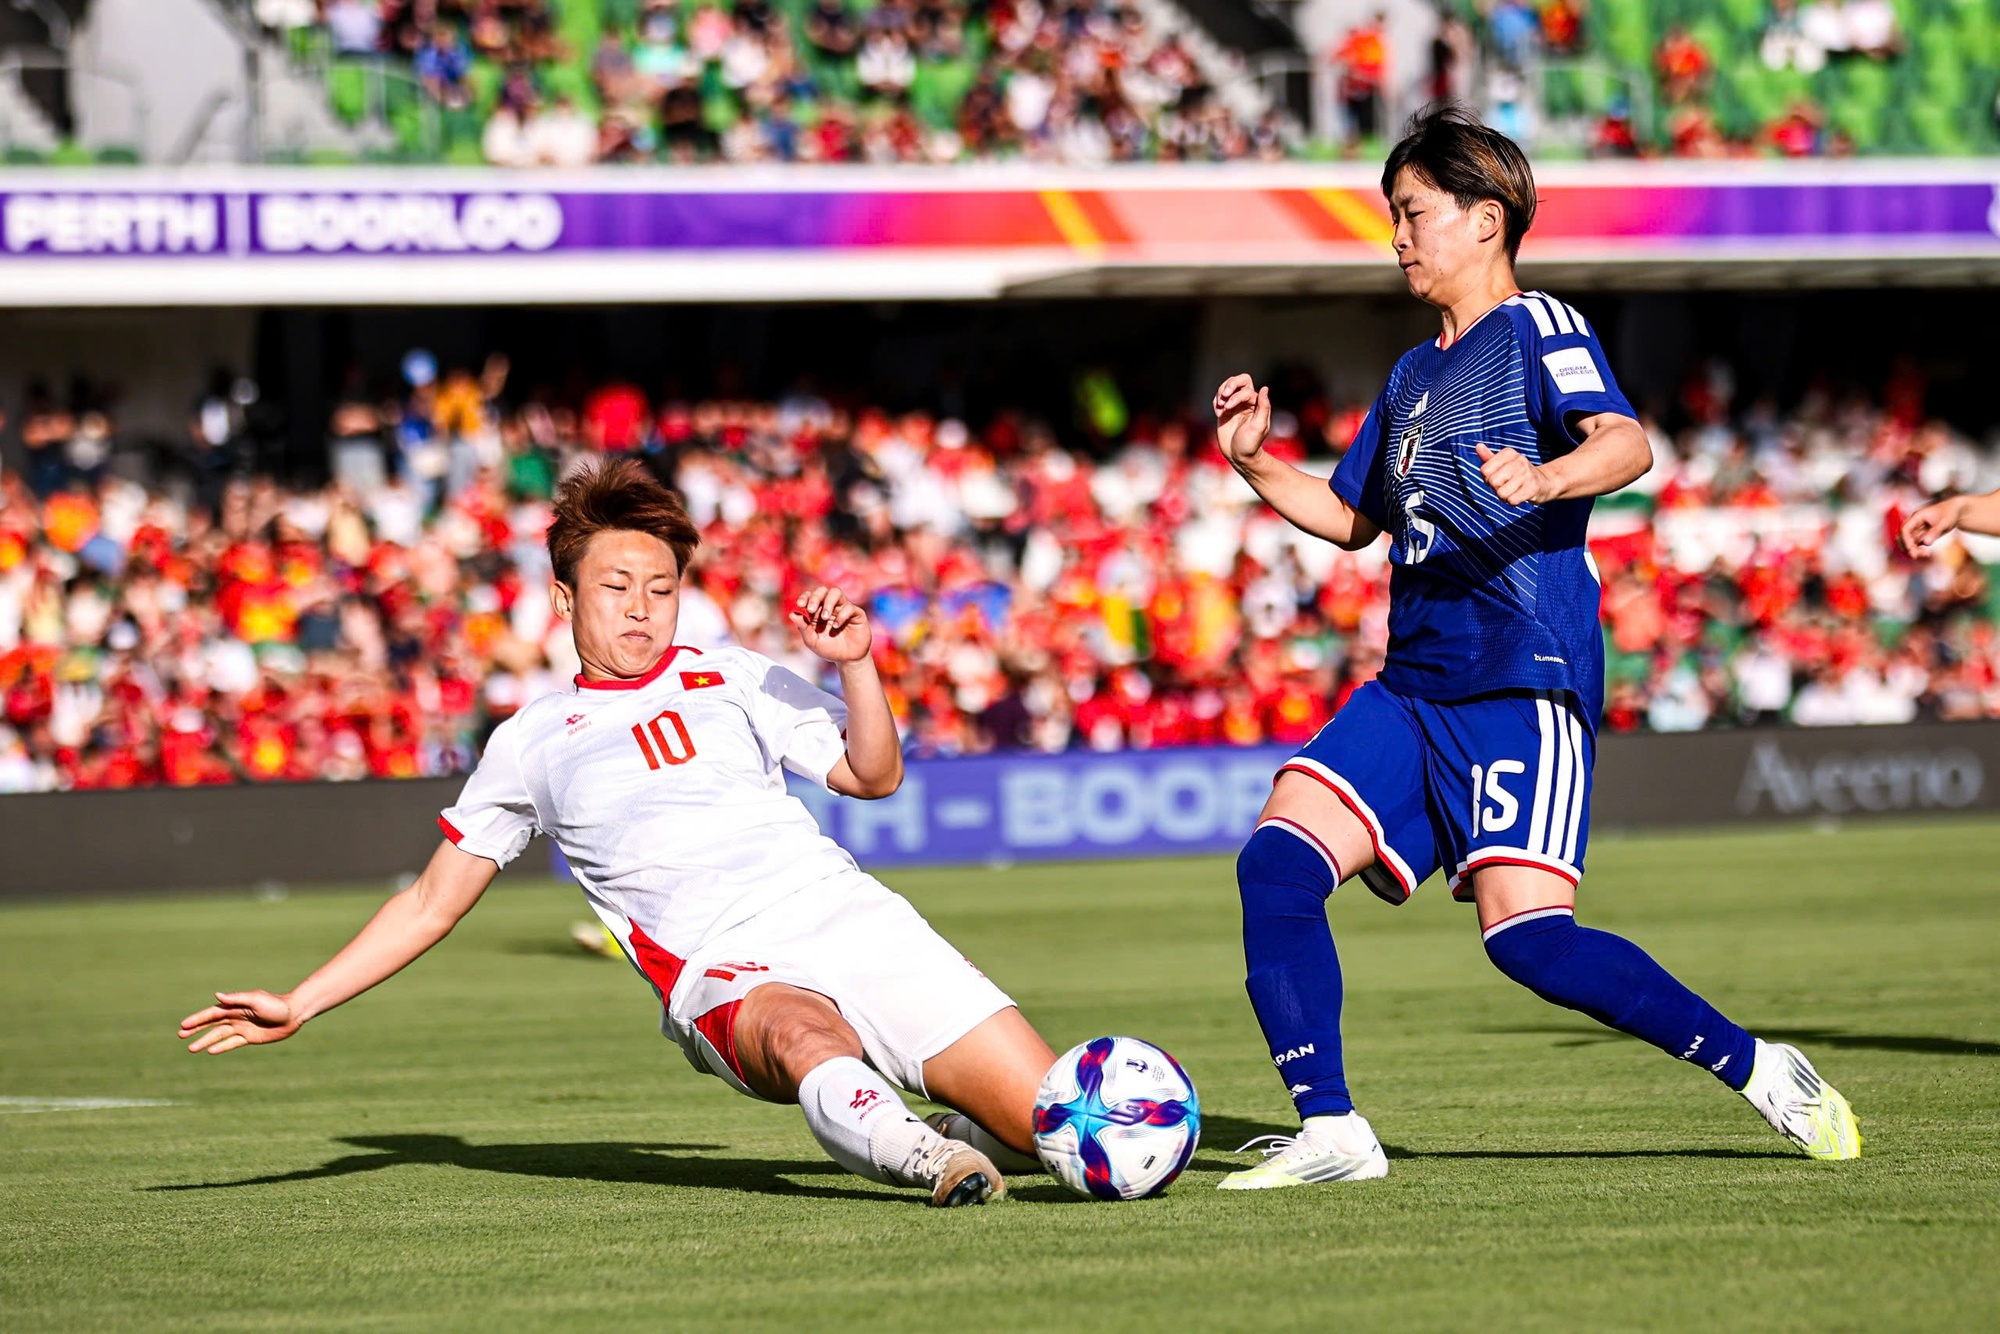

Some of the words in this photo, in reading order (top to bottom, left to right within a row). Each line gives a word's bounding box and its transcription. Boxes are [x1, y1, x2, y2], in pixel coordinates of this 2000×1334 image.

[4, 193, 217, 252] PERTH
[257, 193, 563, 252] BOORLOO
[631, 710, 697, 770] 10
[1471, 759, 1526, 838] 15
[1273, 1043, 1315, 1067] PAN
